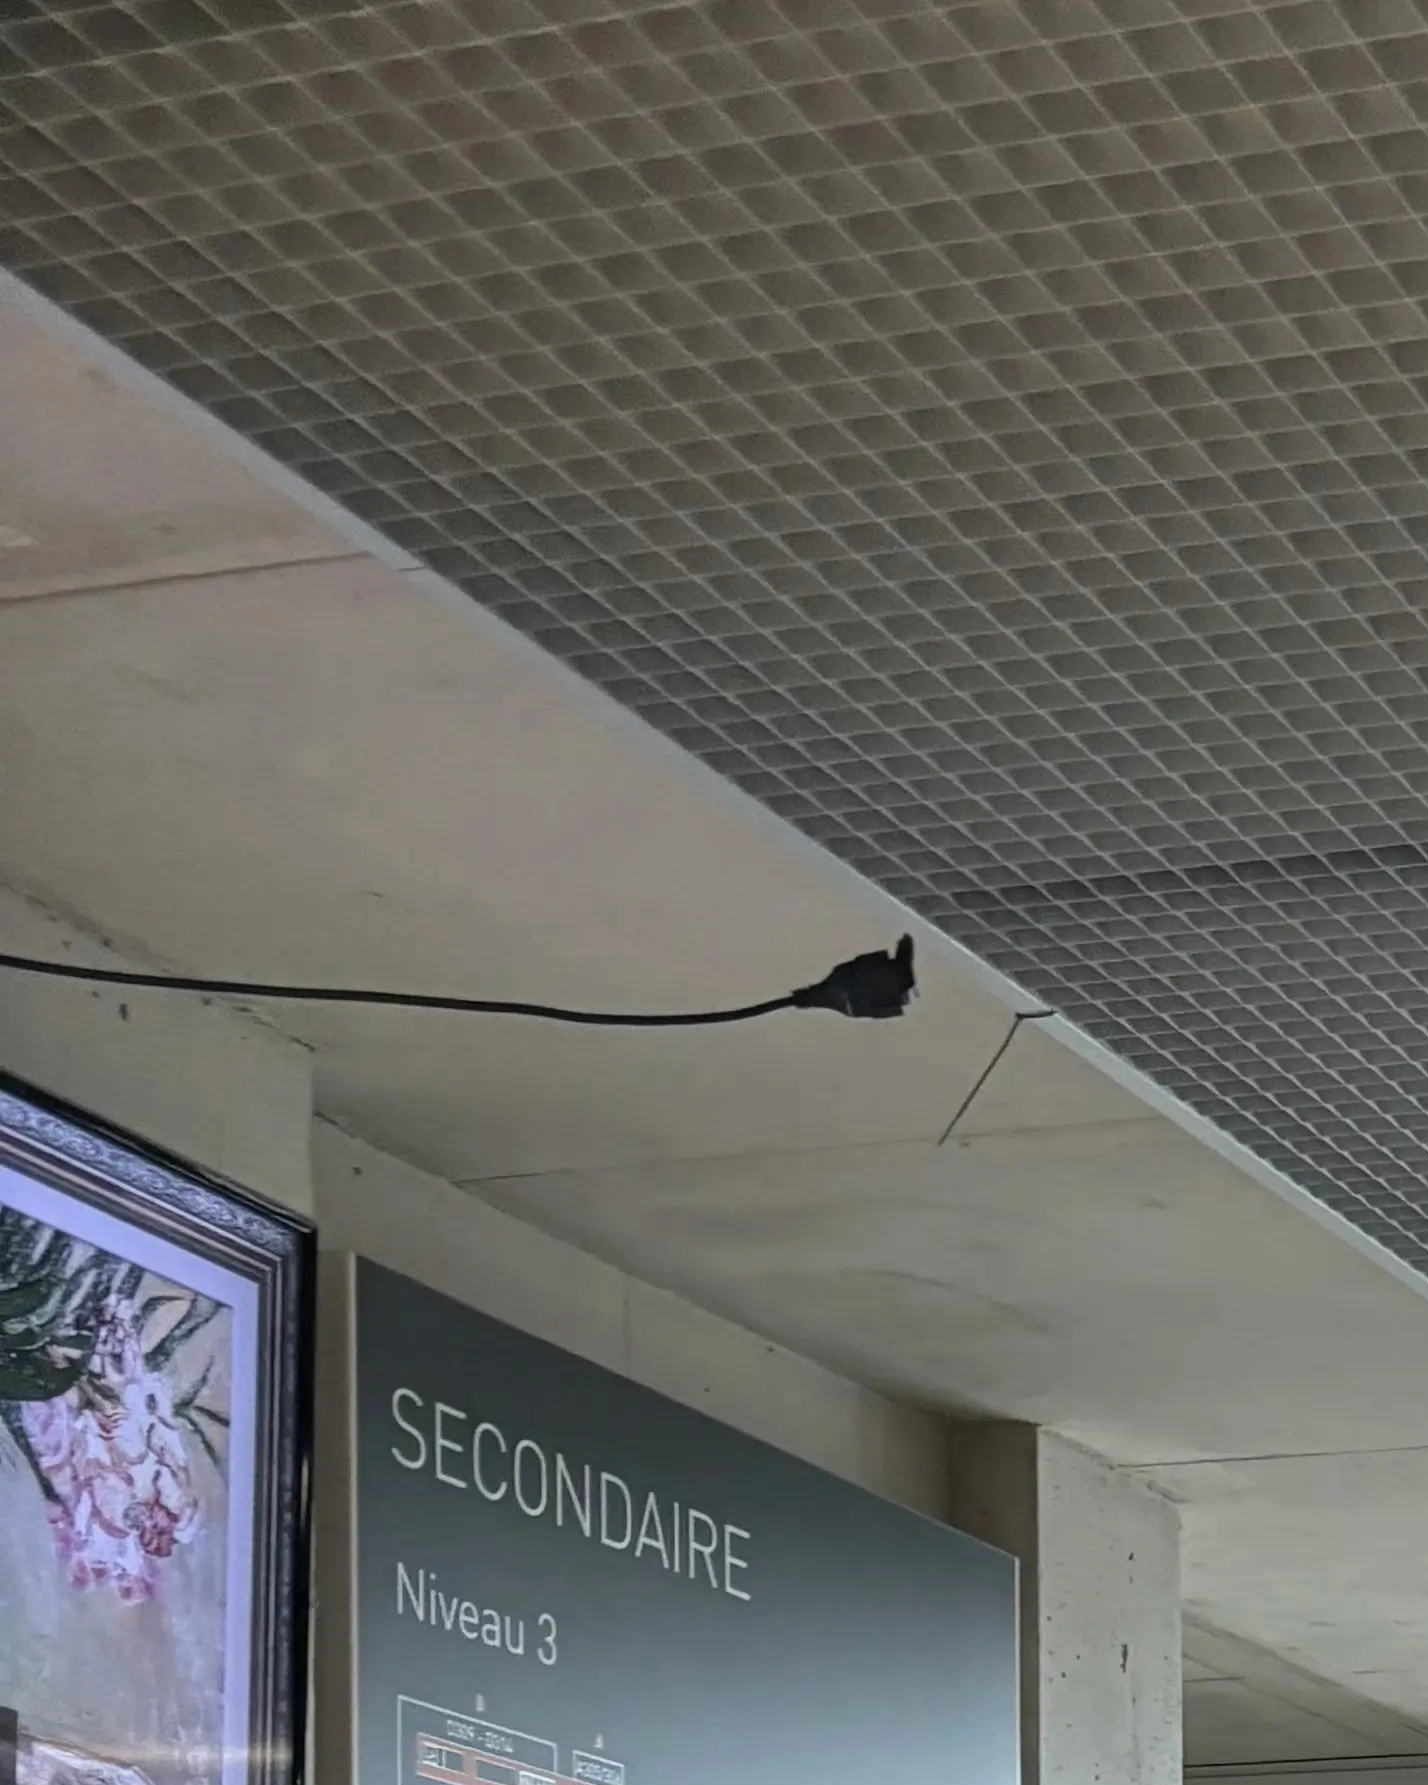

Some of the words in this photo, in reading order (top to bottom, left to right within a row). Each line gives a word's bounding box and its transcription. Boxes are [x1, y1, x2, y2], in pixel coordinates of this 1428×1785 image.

[391, 1388, 751, 1600] SECONDAIRE
[396, 1562, 524, 1656] Niveau
[537, 1613, 557, 1665] 3
